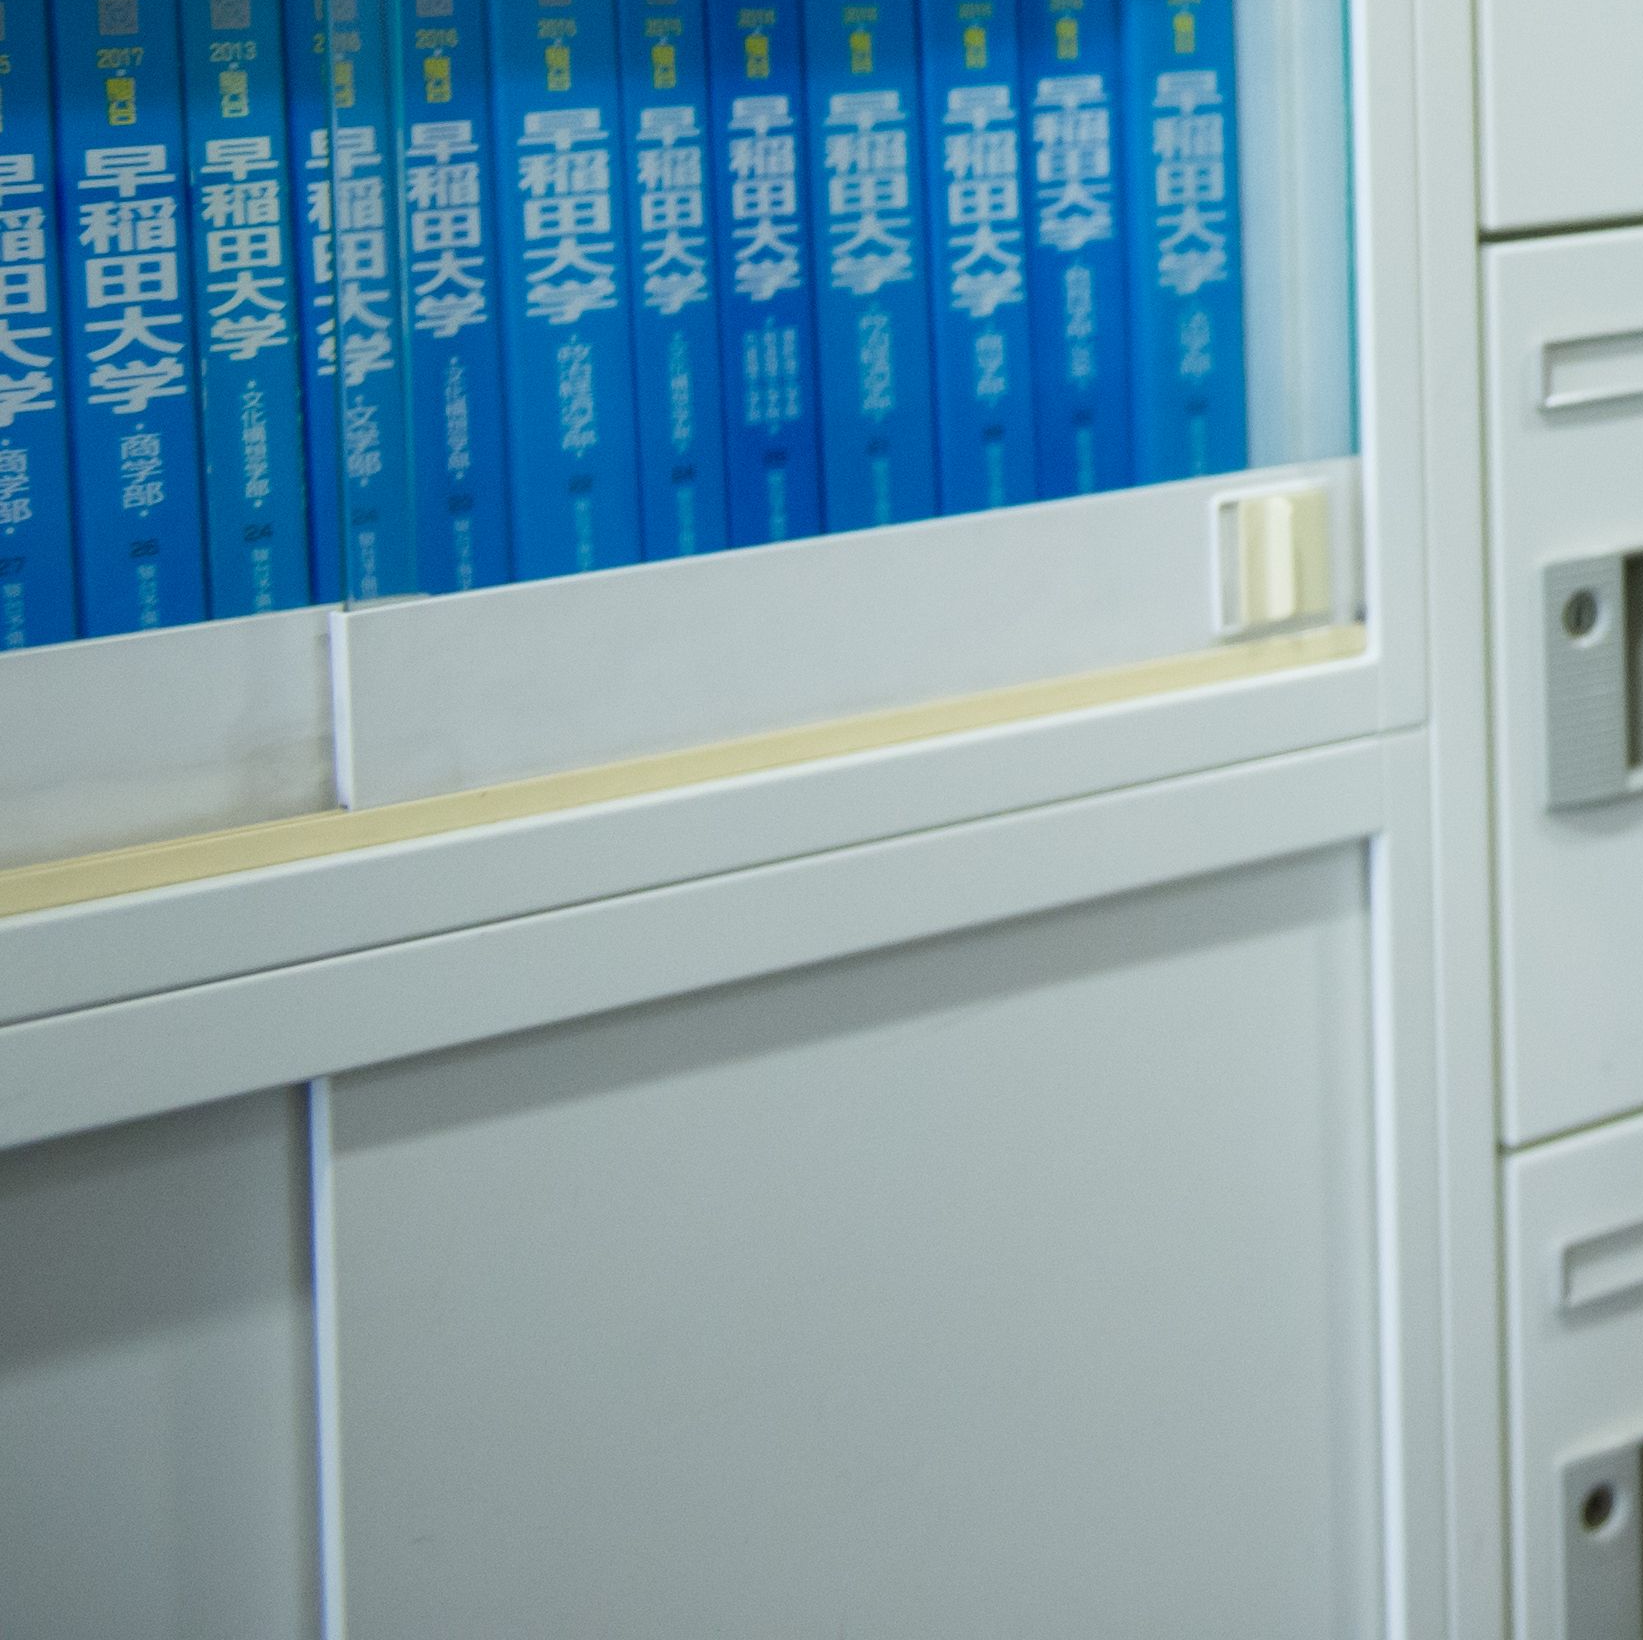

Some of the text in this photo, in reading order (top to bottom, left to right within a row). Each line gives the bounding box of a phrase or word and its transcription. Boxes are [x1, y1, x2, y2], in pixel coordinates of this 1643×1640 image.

[201, 136, 289, 361] 早稲田大学
[405, 120, 488, 338] 早稲田大学
[517, 108, 619, 325] 早稲田大学
[636, 106, 708, 315] 早稲田大学
[728, 96, 803, 302] 早稲田大学
[824, 90, 912, 295] 早稲田大学
[943, 85, 1024, 318] 早稲田大学
[1033, 74, 1114, 252] 早稲田大学
[1152, 70, 1228, 296] 早稲田大学
[77, 144, 188, 510] 早稲田大学 商学部
